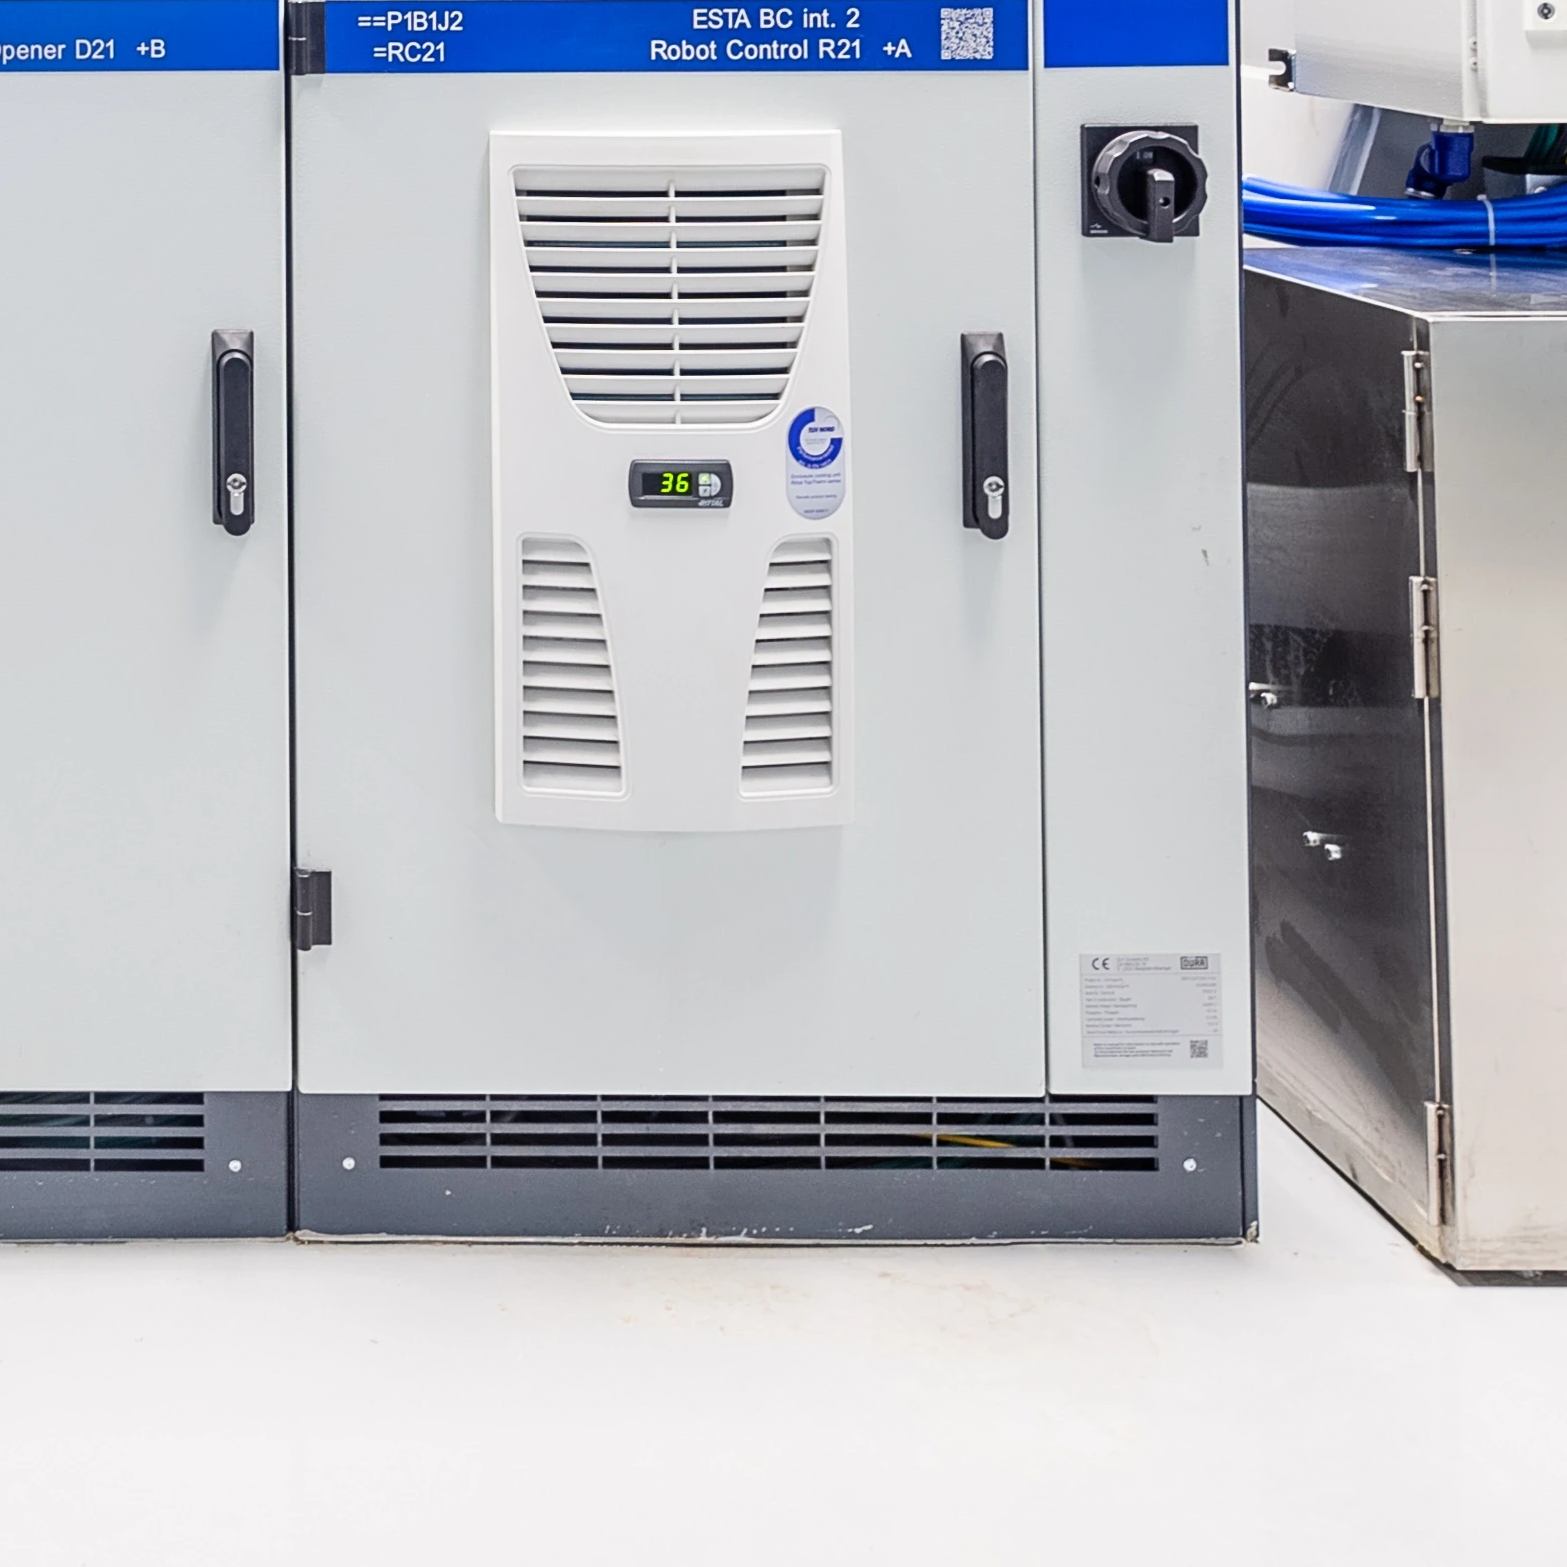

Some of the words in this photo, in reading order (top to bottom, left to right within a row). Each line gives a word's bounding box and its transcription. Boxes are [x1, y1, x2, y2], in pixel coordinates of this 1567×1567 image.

[357, 10, 464, 32] ==P1B1J2
[692, 8, 752, 30] ESTA
[759, 7, 793, 29] BC
[803, 7, 836, 29] int.
[846, 7, 860, 28] 2
[75, 38, 114, 60] D21
[136, 38, 166, 59] +B
[373, 41, 445, 63] =RC21
[650, 39, 718, 61] Robot
[726, 38, 808, 60] Control
[818, 38, 861, 59] R21
[882, 38, 912, 58] +A
[661, 472, 690, 493] 36
